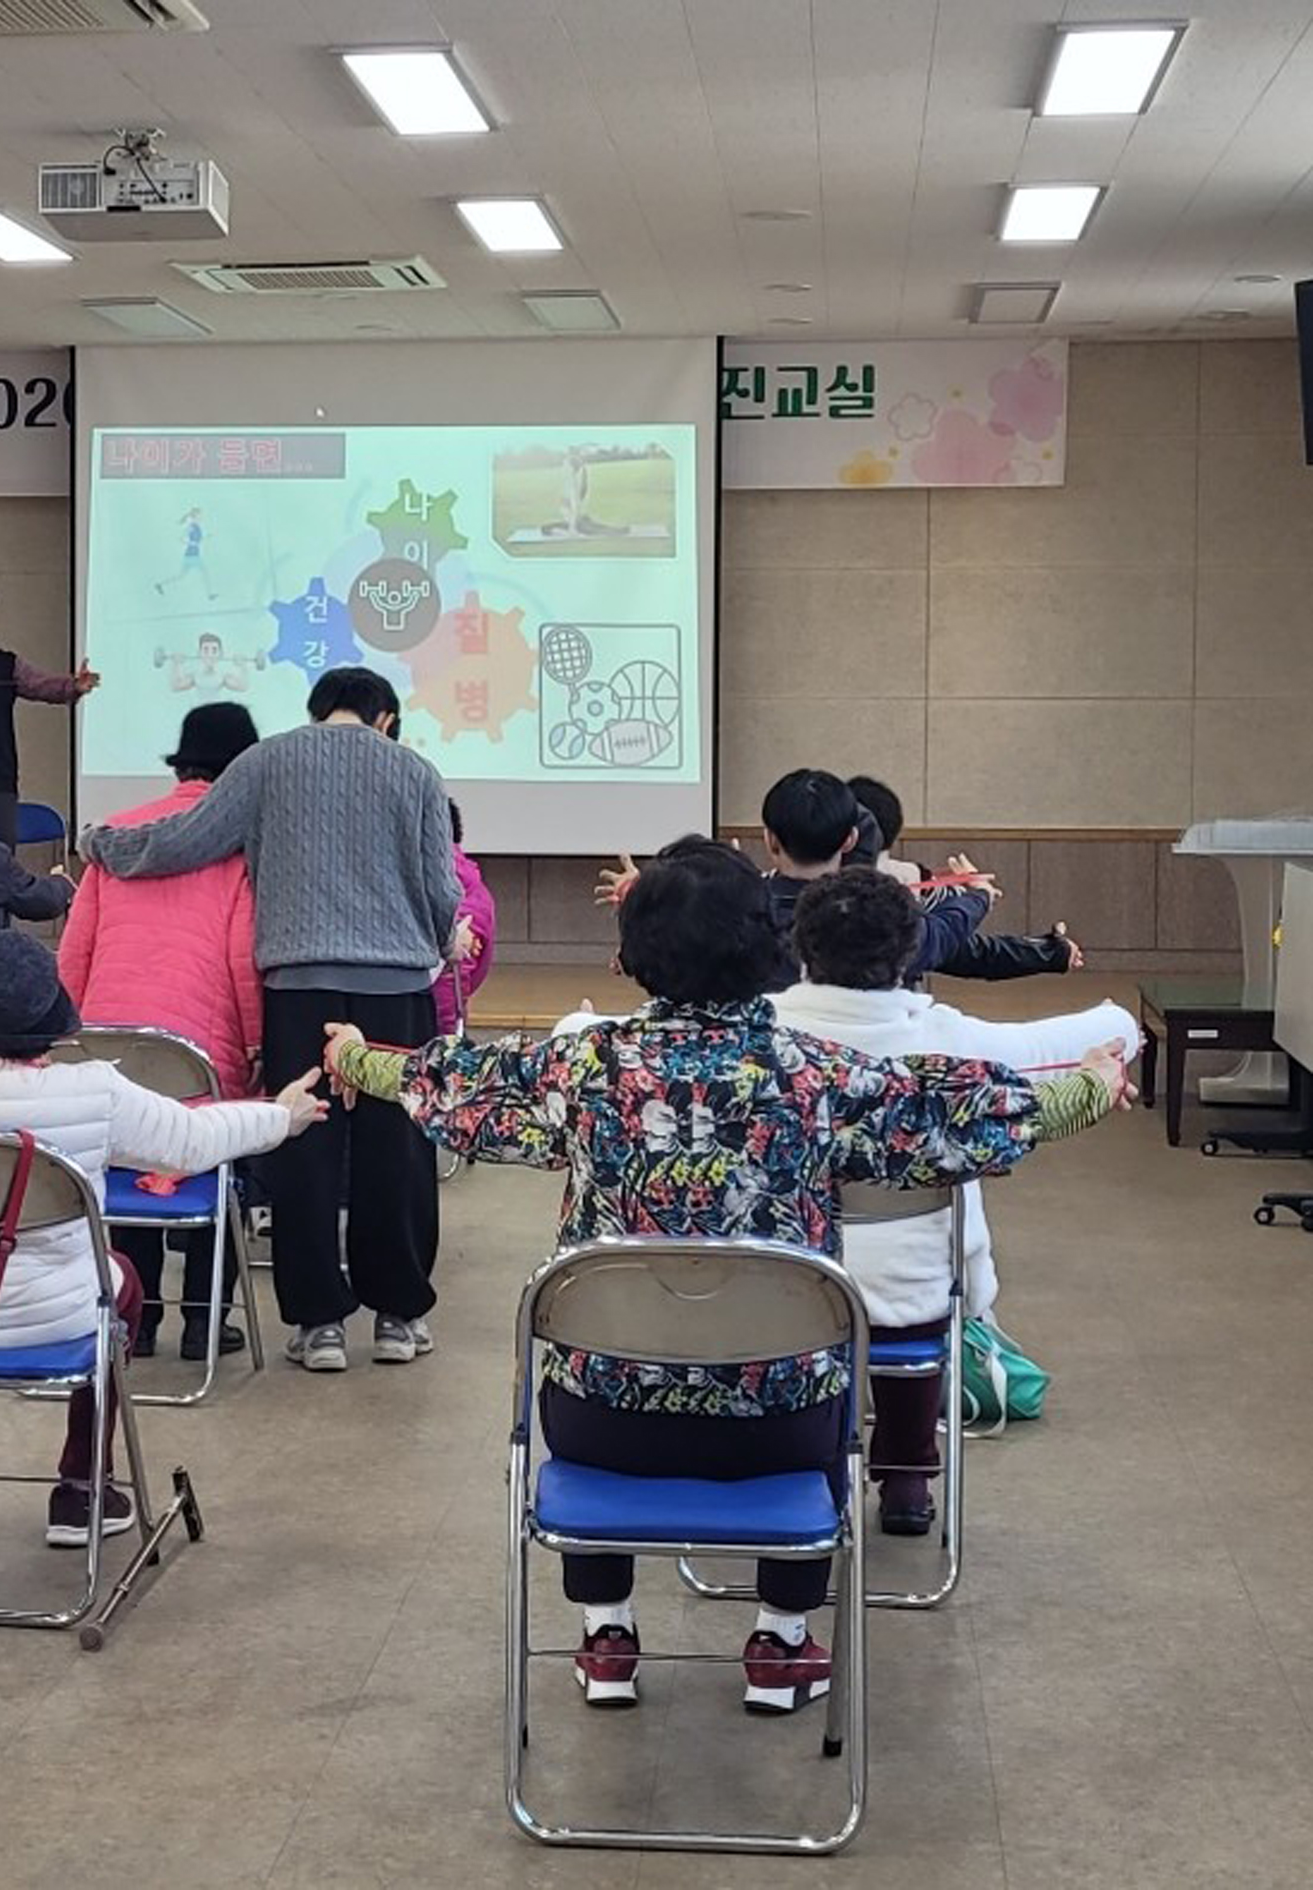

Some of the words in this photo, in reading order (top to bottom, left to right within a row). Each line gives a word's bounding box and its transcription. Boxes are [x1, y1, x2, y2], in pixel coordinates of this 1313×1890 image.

[722, 364, 875, 419] 진교실
[104, 437, 206, 474] 나이가
[404, 491, 434, 570] 나이
[303, 596, 329, 668] 건강
